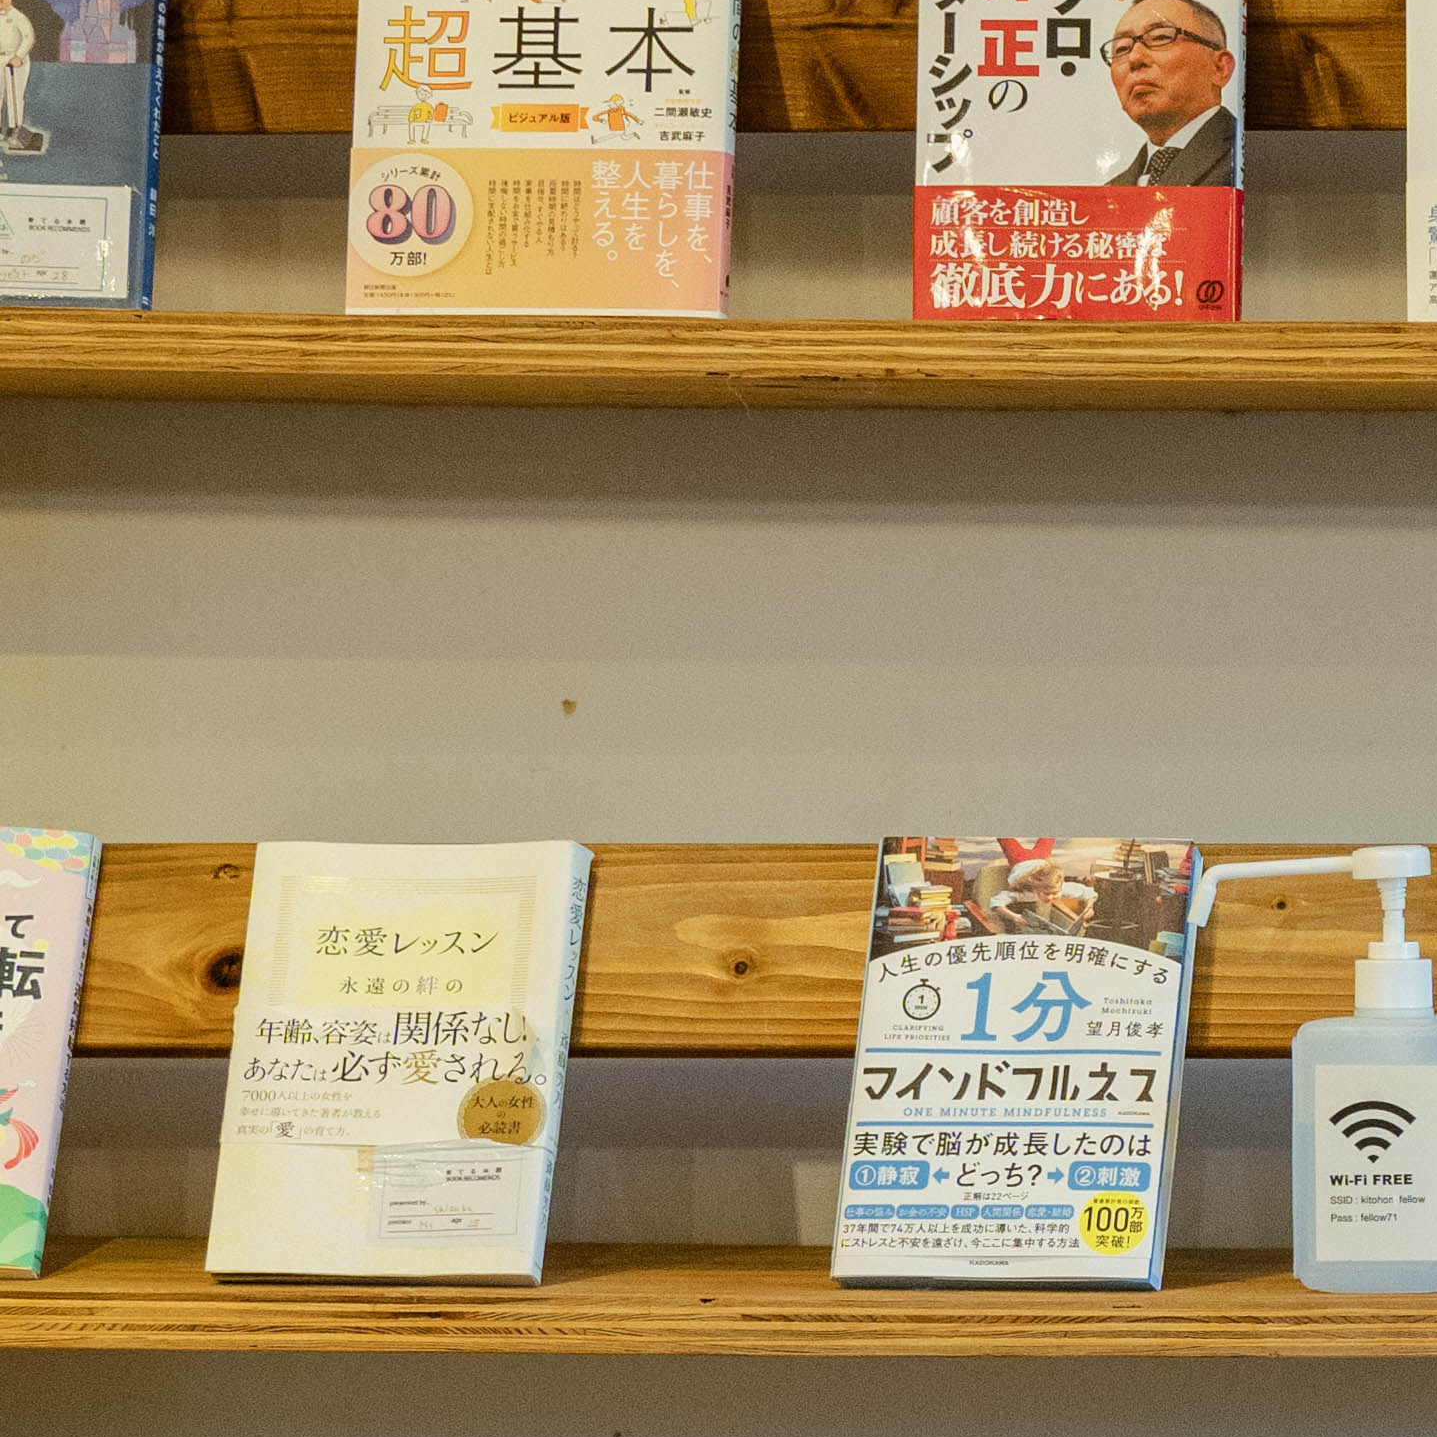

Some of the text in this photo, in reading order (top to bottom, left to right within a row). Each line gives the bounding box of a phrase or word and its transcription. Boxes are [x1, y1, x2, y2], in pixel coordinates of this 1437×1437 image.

[379, 6, 697, 93] 超基本
[508, 112, 572, 125] ビジュアル版
[366, 184, 459, 246] 80
[592, 160, 619, 262] 整える。
[623, 160, 653, 252] 人生を
[685, 160, 714, 264] 仕事を、
[931, 199, 1089, 227] 顧客を創造し
[654, 160, 685, 290] 暮らしを、
[315, 926, 498, 957] 恋愛レッスン
[878, 940, 1169, 985] 人生の優先順位を明確にする
[339, 977, 464, 996] 永遠の絆の
[960, 970, 1093, 1043] 1分
[1104, 997, 1153, 1006] Toshitaka
[1085, 1020, 1163, 1038] 望月俊孝
[244, 1050, 548, 1085] あなたは必ず愛される。
[862, 1061, 1158, 1103] マインドフルネス
[904, 1107, 1107, 1118] ONE MINUTE MINDFULNESS
[853, 1132, 1152, 1157] 実験で脳が成長したのは
[1330, 1174, 1413, 1186] Wi-Fi FREE
[1330, 1195, 1353, 1204] SSID
[1083, 1207, 1131, 1234] 100
[1331, 1213, 1397, 1222] Pass fellow71
